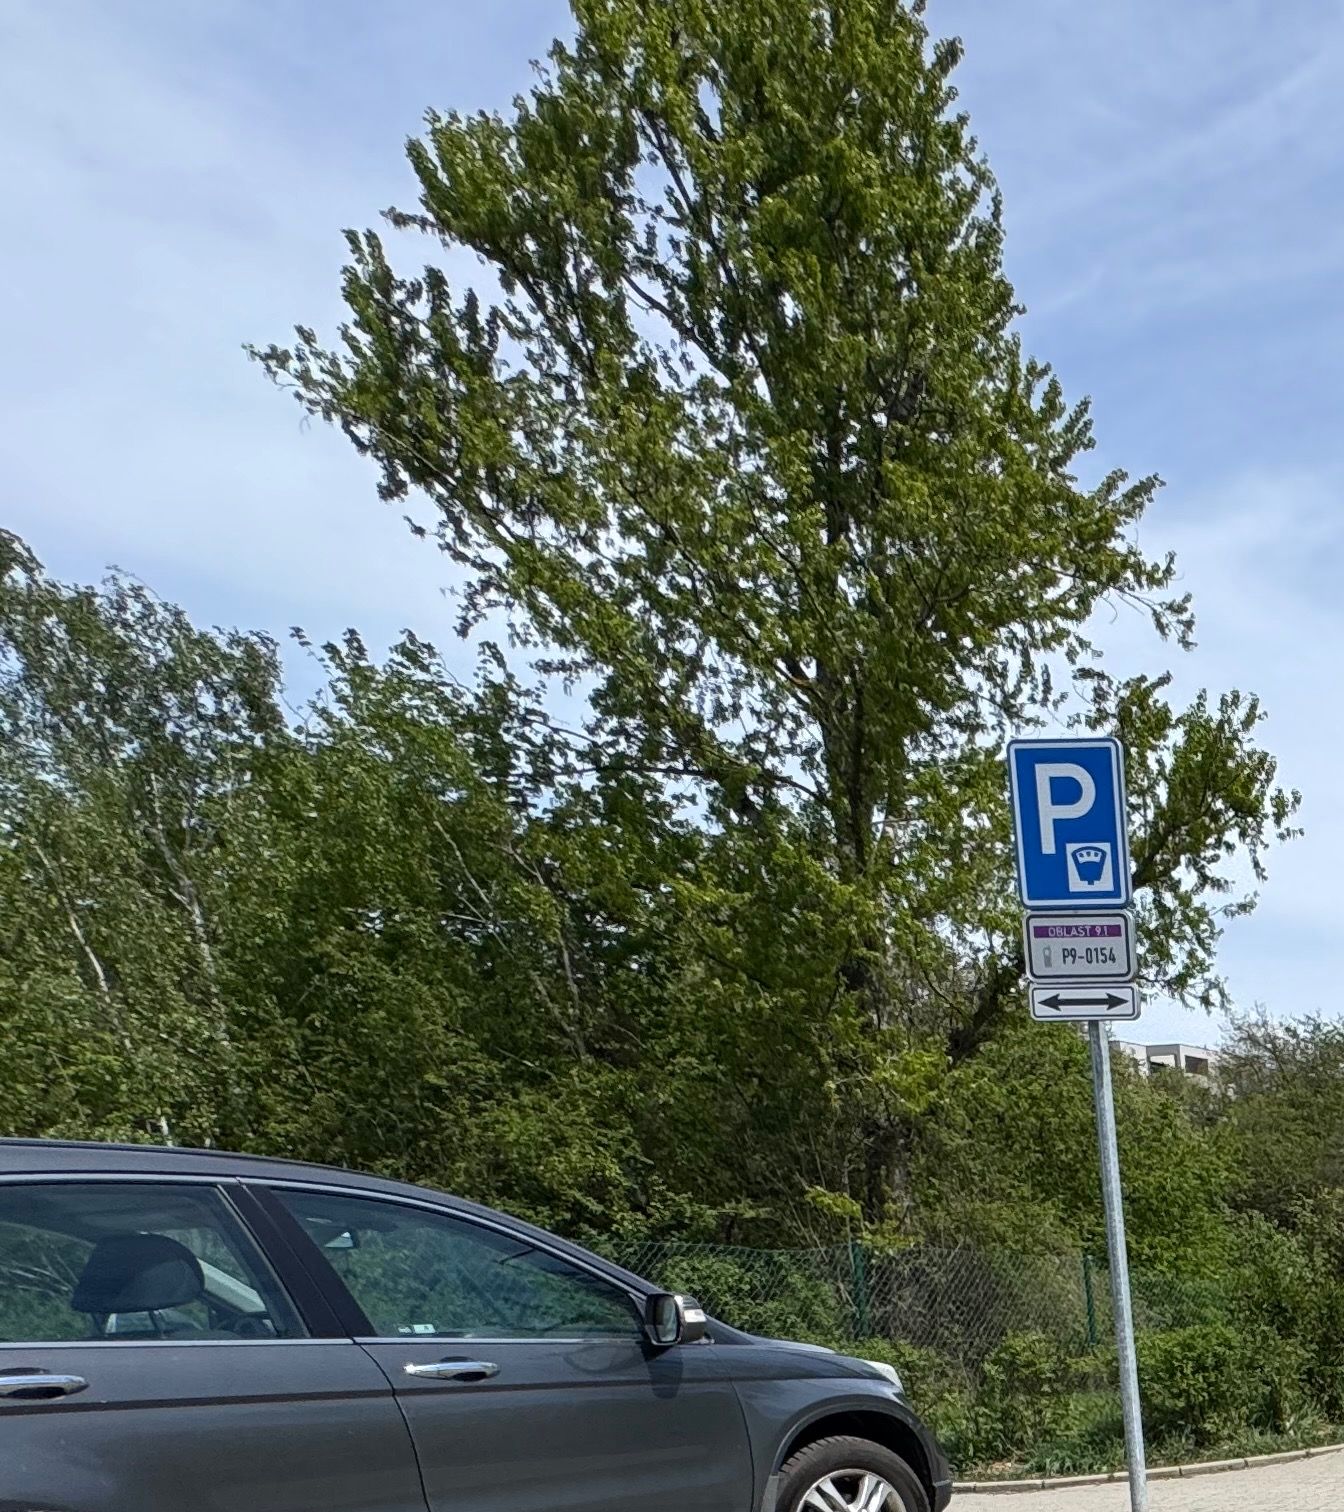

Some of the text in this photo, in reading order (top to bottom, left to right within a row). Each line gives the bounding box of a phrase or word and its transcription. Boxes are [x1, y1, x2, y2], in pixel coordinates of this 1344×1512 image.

[1034, 763, 1096, 854] P
[1048, 925, 1091, 937] OBLAST
[1062, 947, 1116, 965] P9-0154
